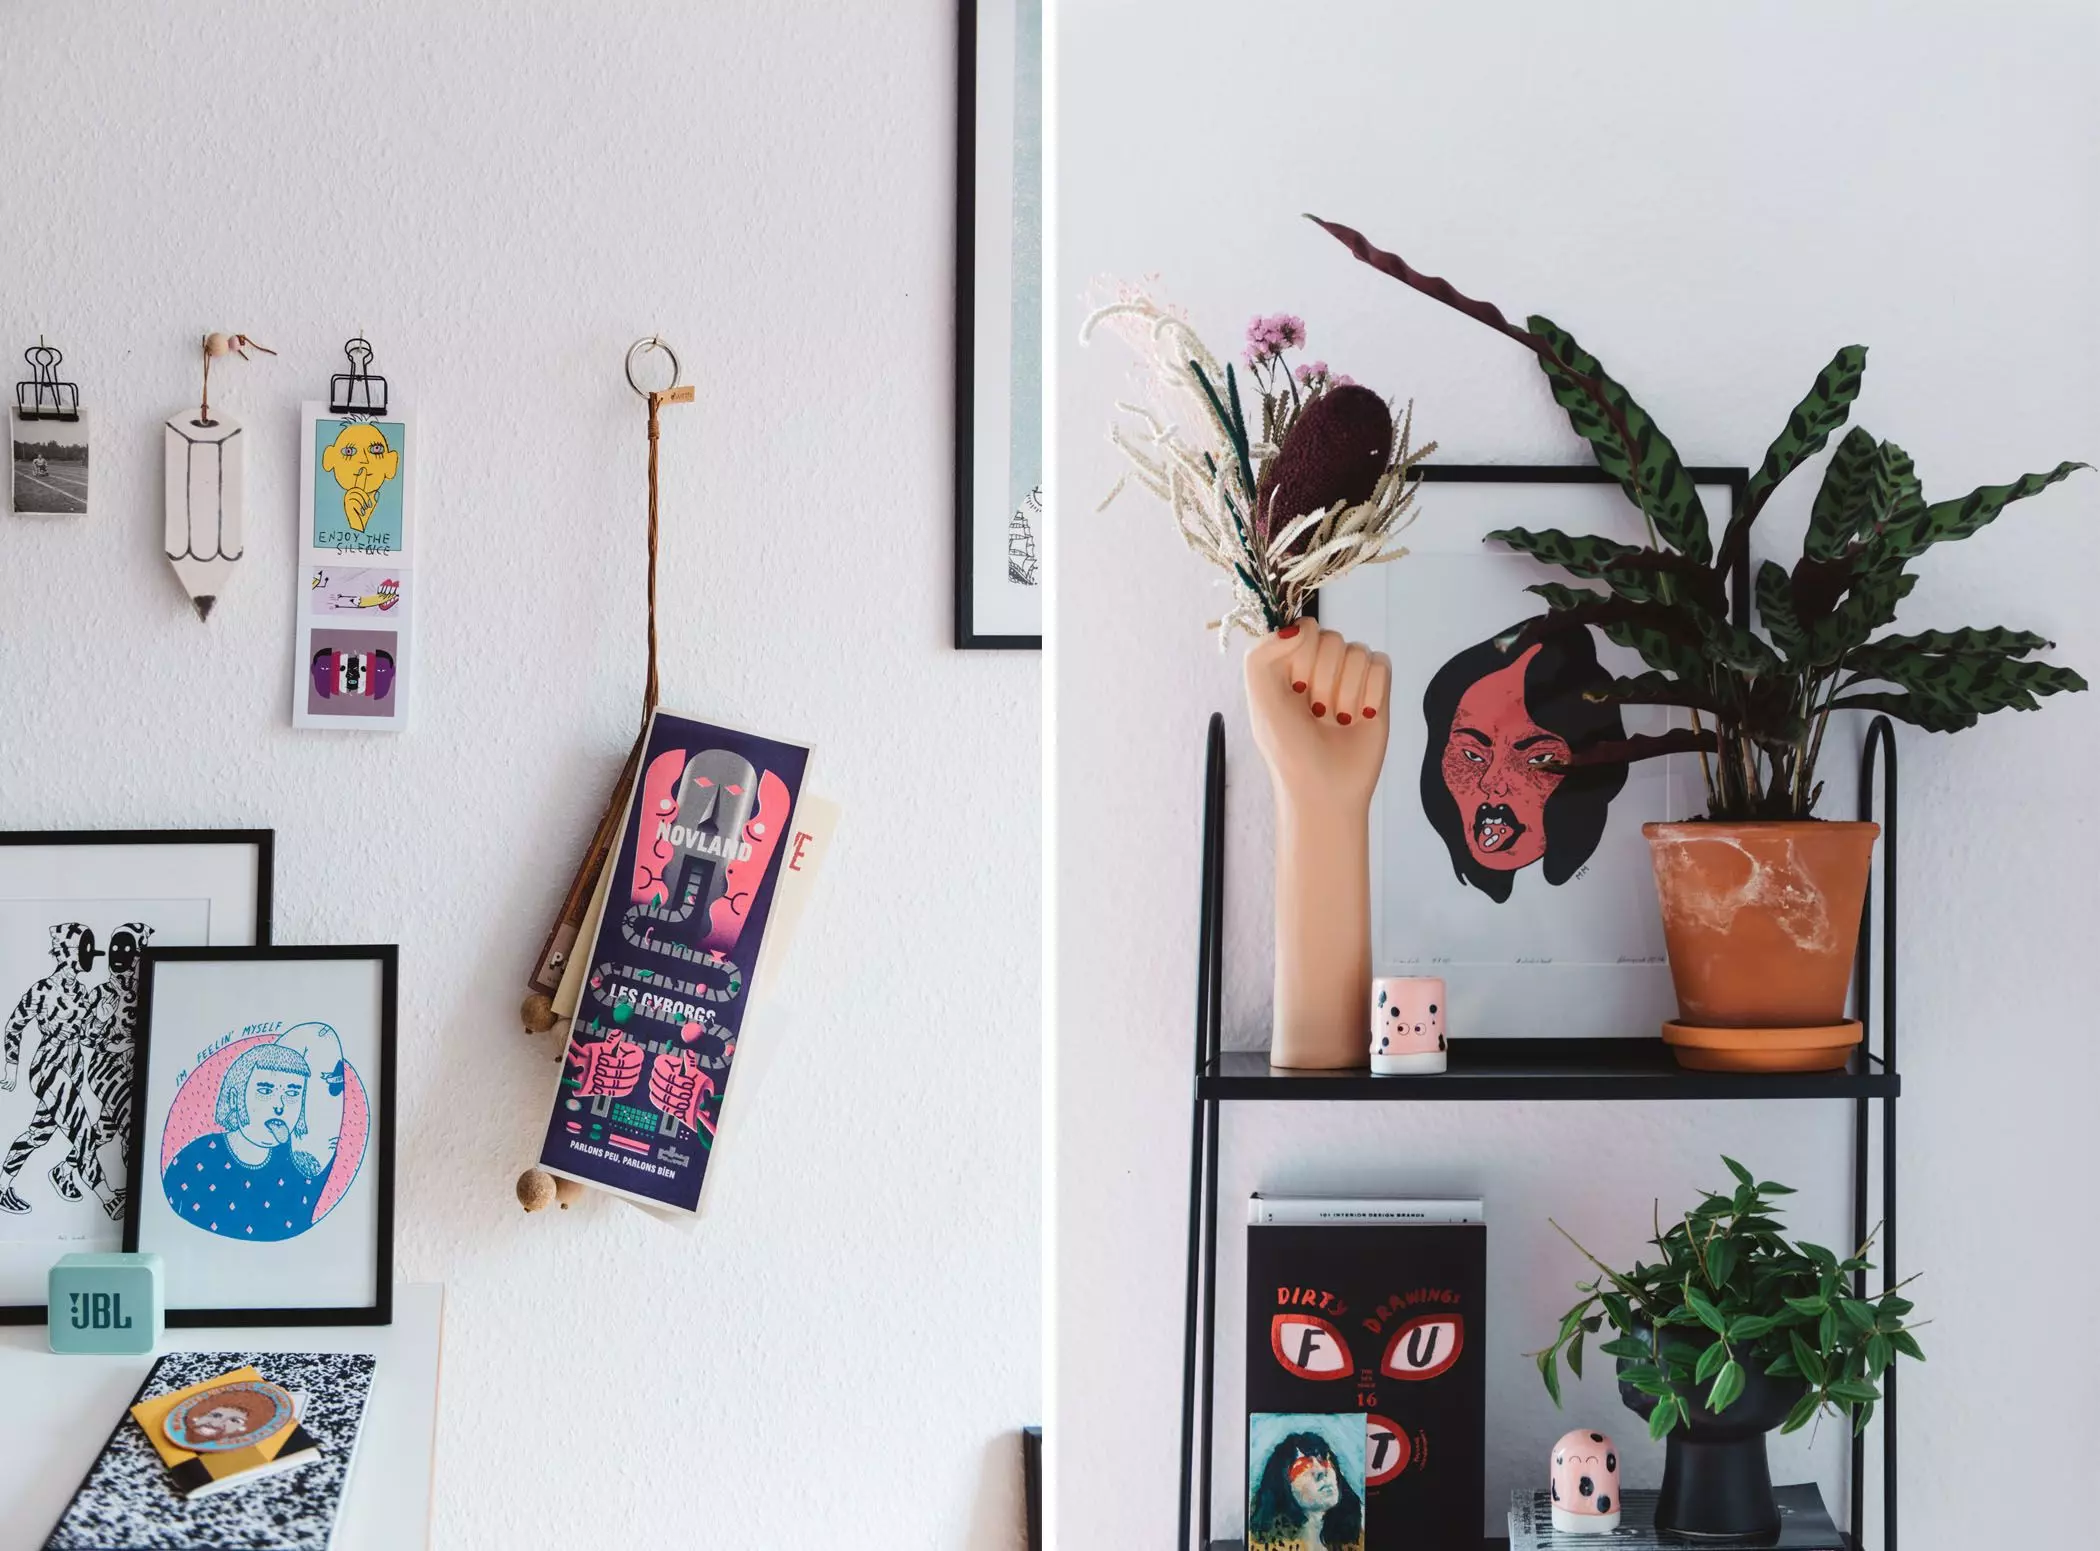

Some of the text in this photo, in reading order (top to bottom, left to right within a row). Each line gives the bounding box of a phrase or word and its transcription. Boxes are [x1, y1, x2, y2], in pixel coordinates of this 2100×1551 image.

[319, 530, 390, 544] ENJOY THE
[656, 820, 753, 862] NOVLAND
[610, 983, 717, 1024] LES CYBORGS
[175, 1021, 283, 1087] I'M FEELIN' MYSELF
[570, 1140, 603, 1157] PARLONS
[622, 1156, 656, 1173] PARLONS
[69, 1292, 132, 1330] JBL
[1277, 1287, 1349, 1317] DIRTY
[1297, 1326, 1440, 1369] F U
[1357, 1391, 1377, 1408] 16
